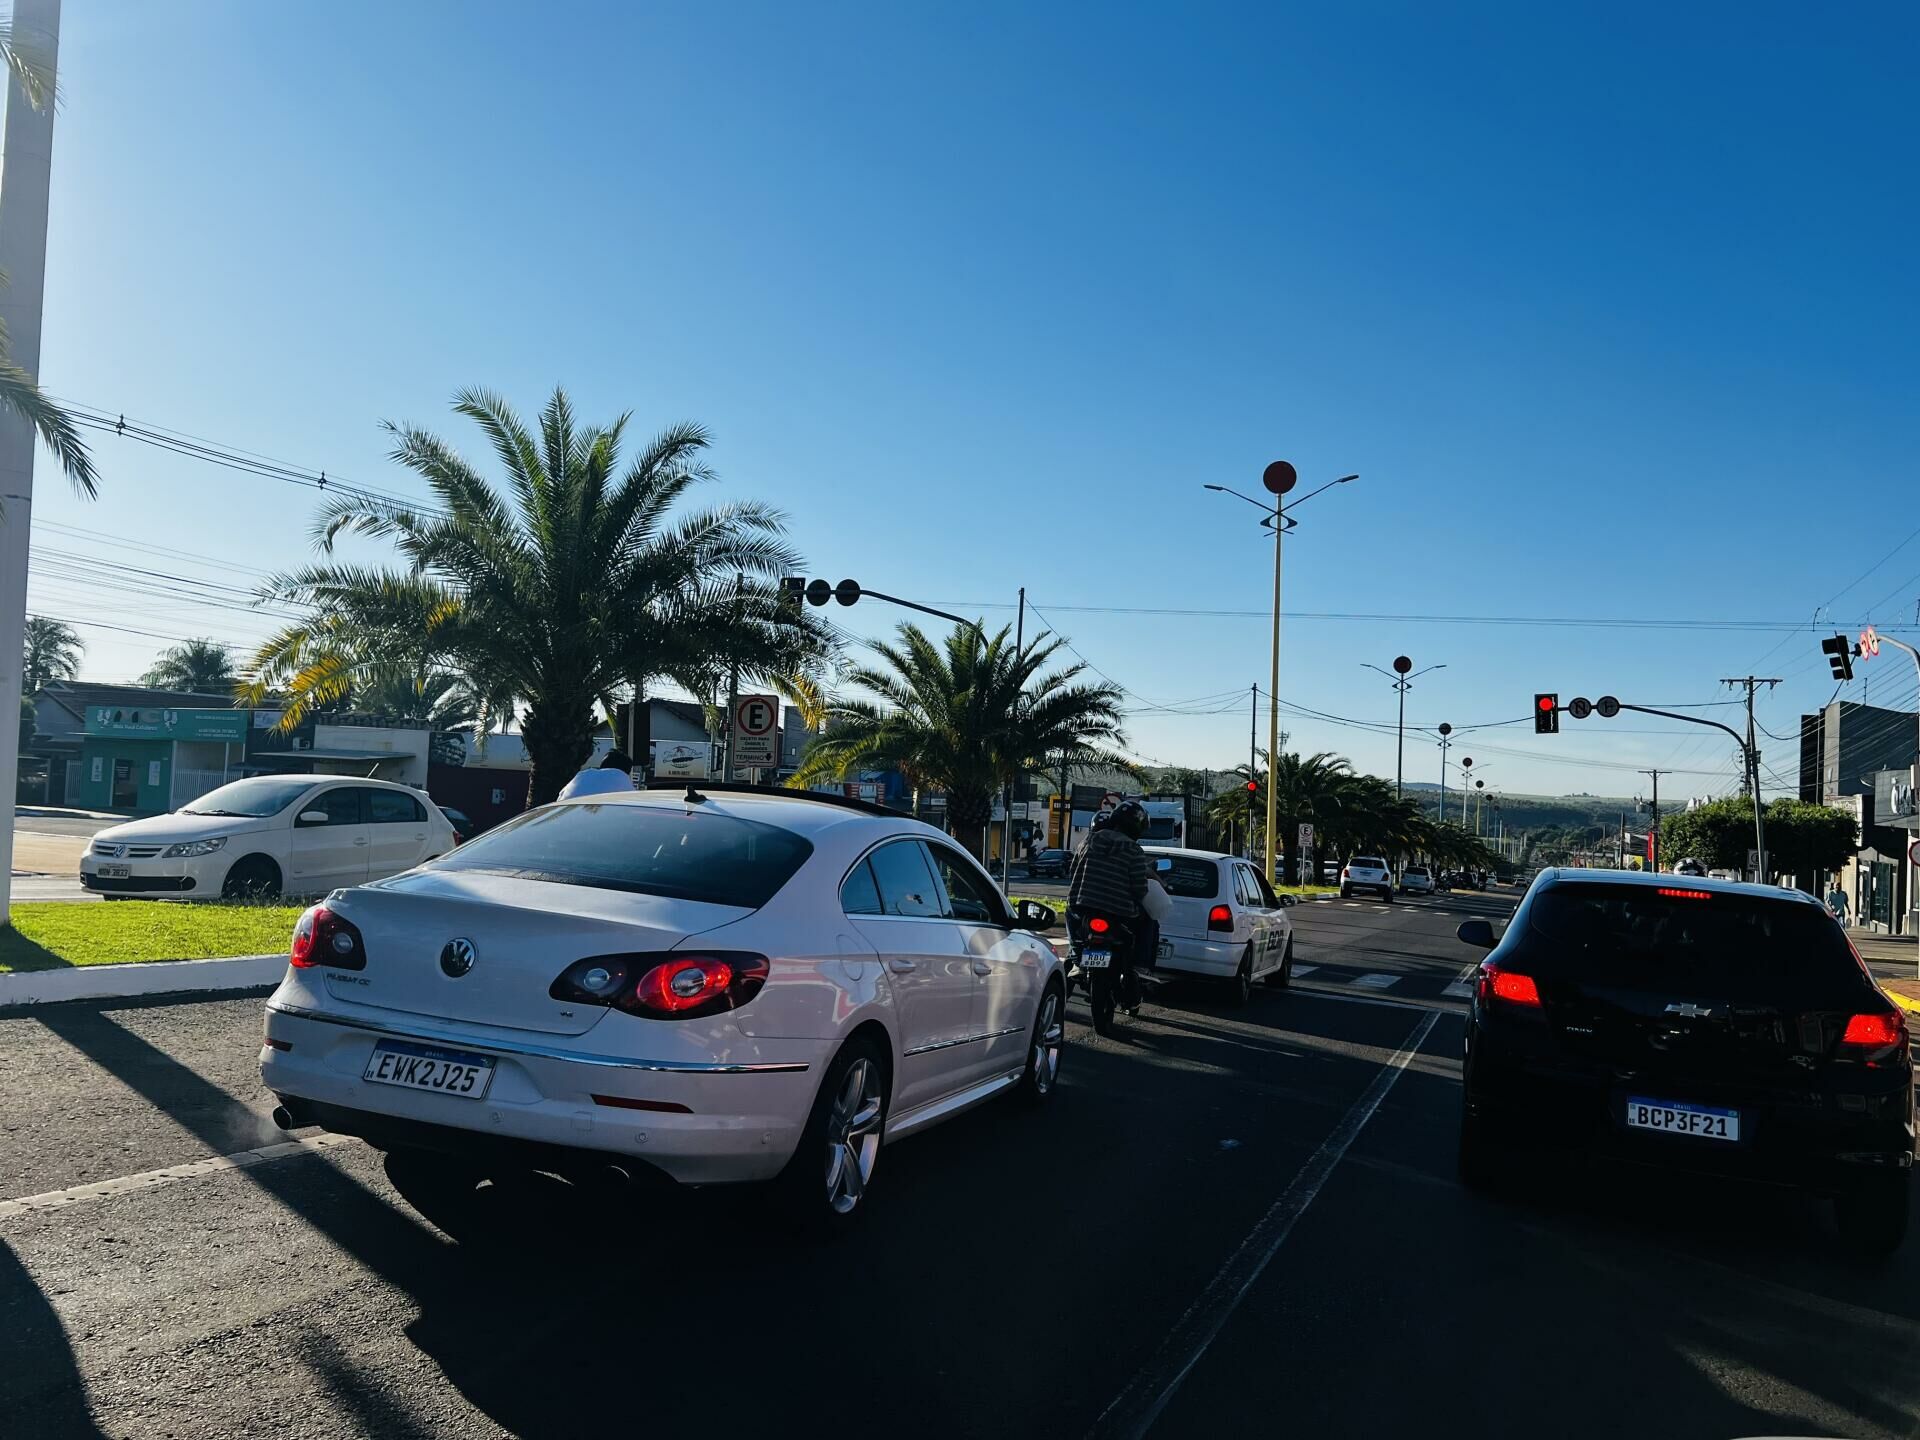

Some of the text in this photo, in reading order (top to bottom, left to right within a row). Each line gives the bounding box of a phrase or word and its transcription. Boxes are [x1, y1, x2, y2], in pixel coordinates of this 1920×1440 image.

[749, 704, 763, 729] E
[376, 1053, 480, 1093] EWK2J25
[1637, 1106, 1728, 1137] BCP3F21
